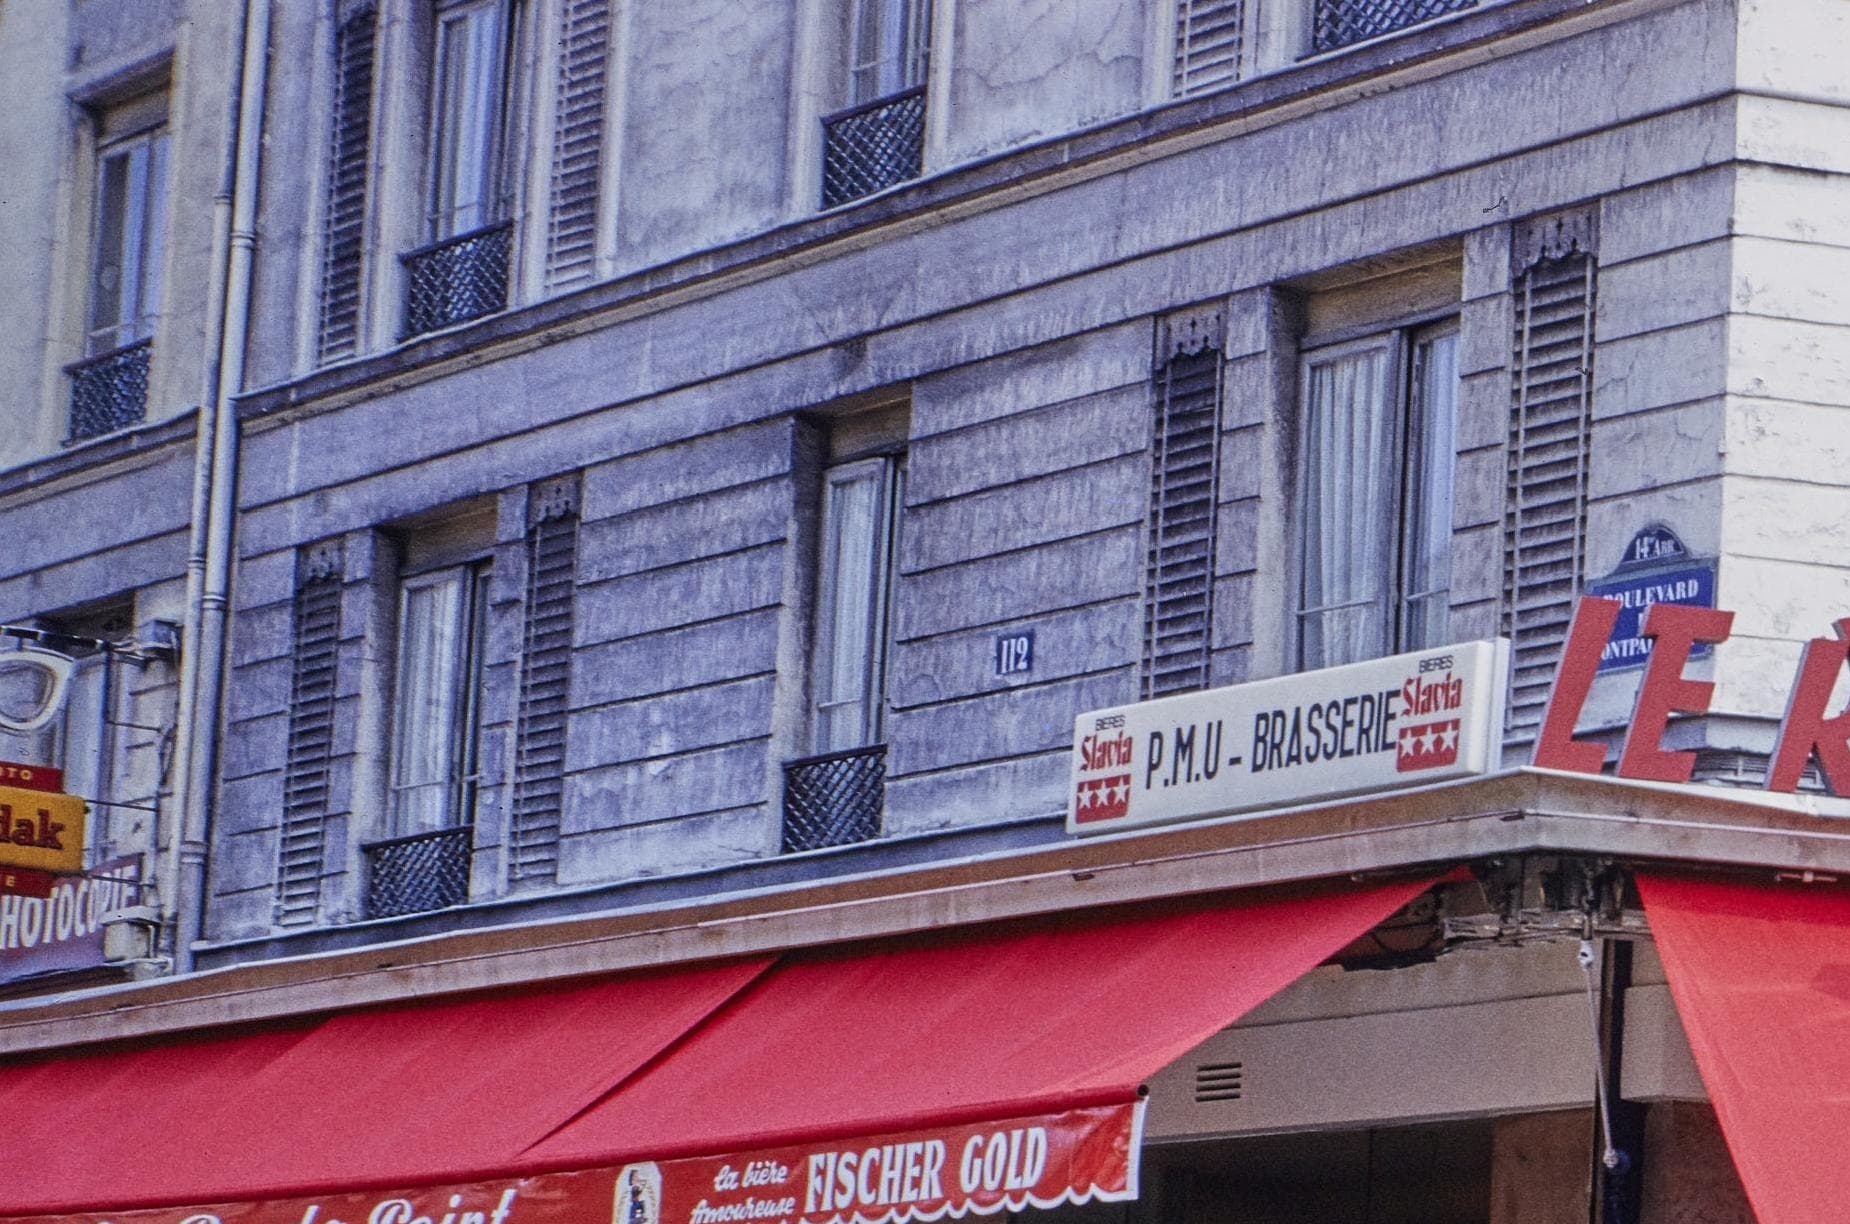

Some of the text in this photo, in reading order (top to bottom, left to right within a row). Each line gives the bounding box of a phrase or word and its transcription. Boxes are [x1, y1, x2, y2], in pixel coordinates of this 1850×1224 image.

[1001, 637, 1029, 674] 112
[1400, 671, 1464, 717] Slavia
[1531, 594, 1736, 783] LE
[1080, 730, 1133, 771] Slavia
[1145, 719, 1223, 790] P.M.U
[1251, 689, 1402, 773] BRASSERIE
[714, 1158, 788, 1189] la bière
[804, 1126, 1048, 1214] FISCHER GOLD
